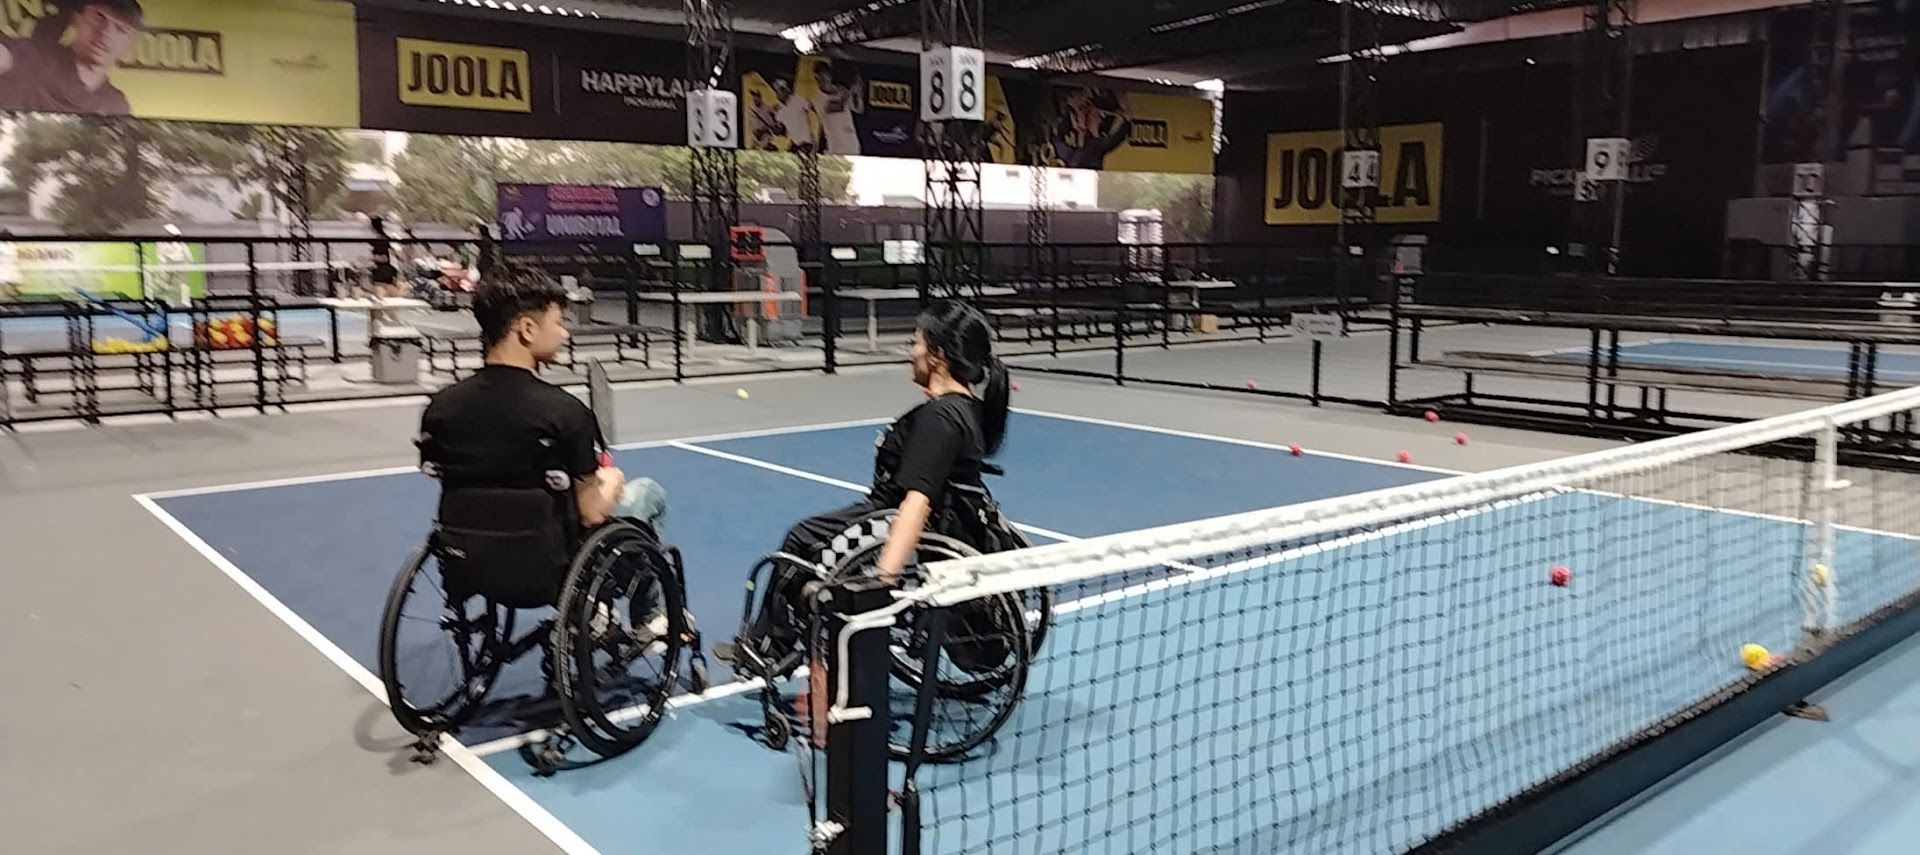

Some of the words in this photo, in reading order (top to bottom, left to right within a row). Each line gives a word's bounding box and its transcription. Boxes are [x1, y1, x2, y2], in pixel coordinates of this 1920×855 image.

[407, 50, 523, 102] JOOLA
[929, 68, 945, 115] 8
[960, 67, 977, 113] 8
[712, 106, 731, 142] 3
[1273, 141, 1431, 210] JOA
